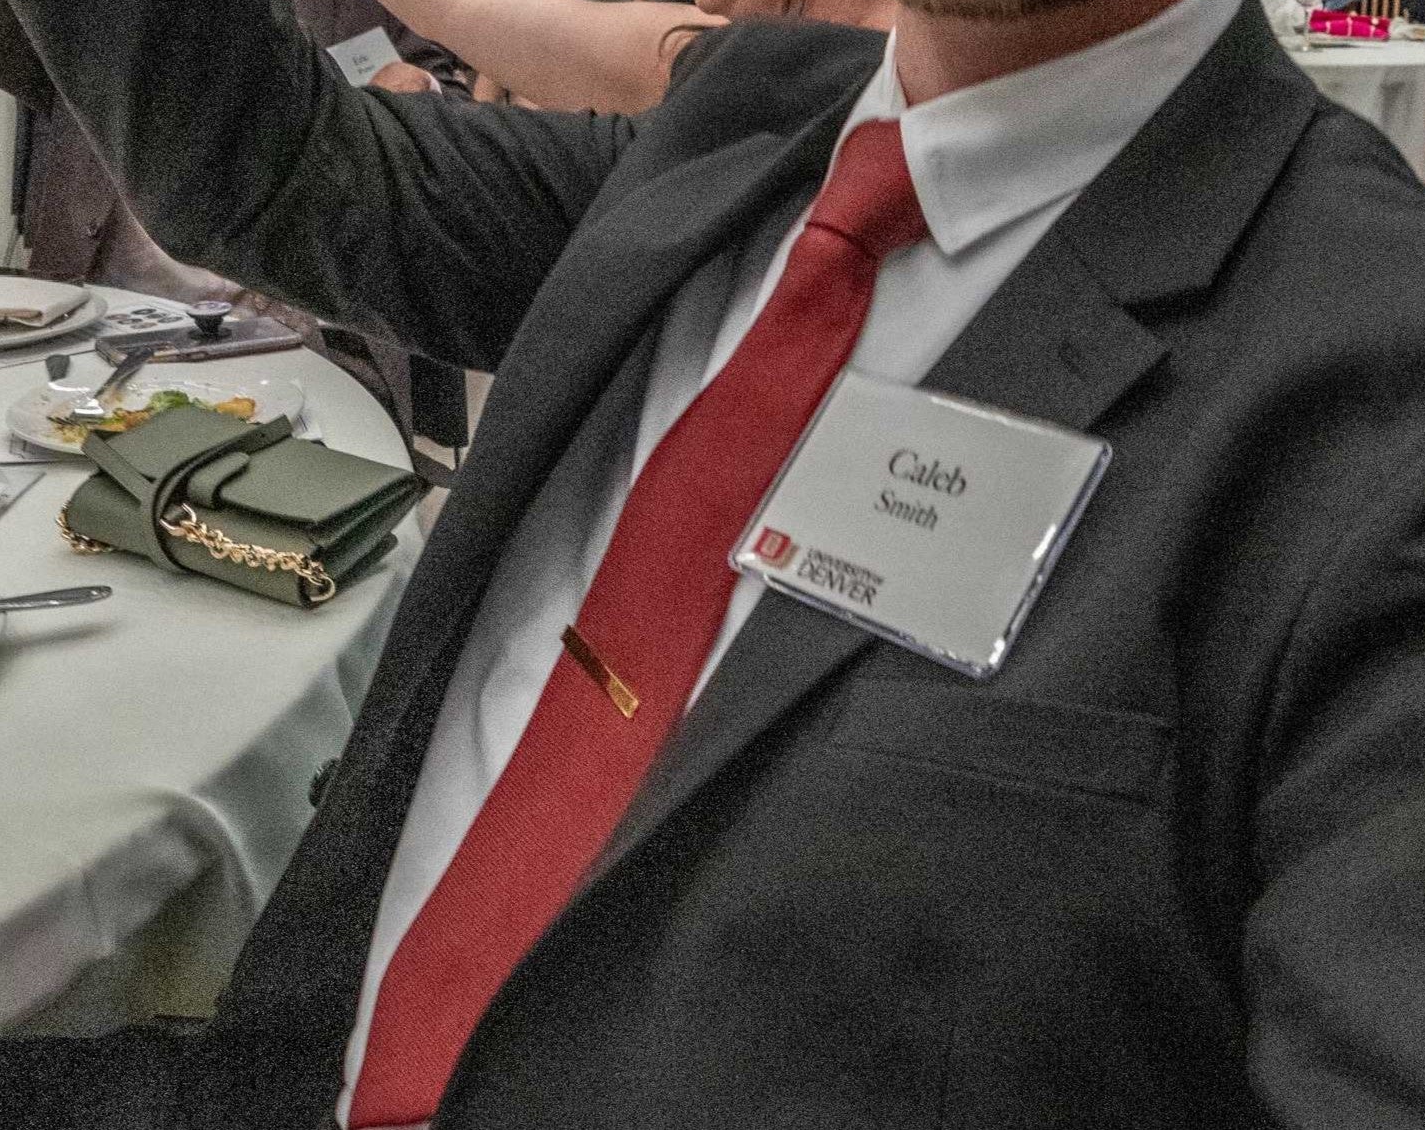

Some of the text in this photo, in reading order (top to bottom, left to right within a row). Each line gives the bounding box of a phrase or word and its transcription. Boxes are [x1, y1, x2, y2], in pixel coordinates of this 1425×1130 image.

[887, 449, 967, 498] Caleb
[873, 489, 938, 532] Smith
[797, 558, 877, 606] DENVER
